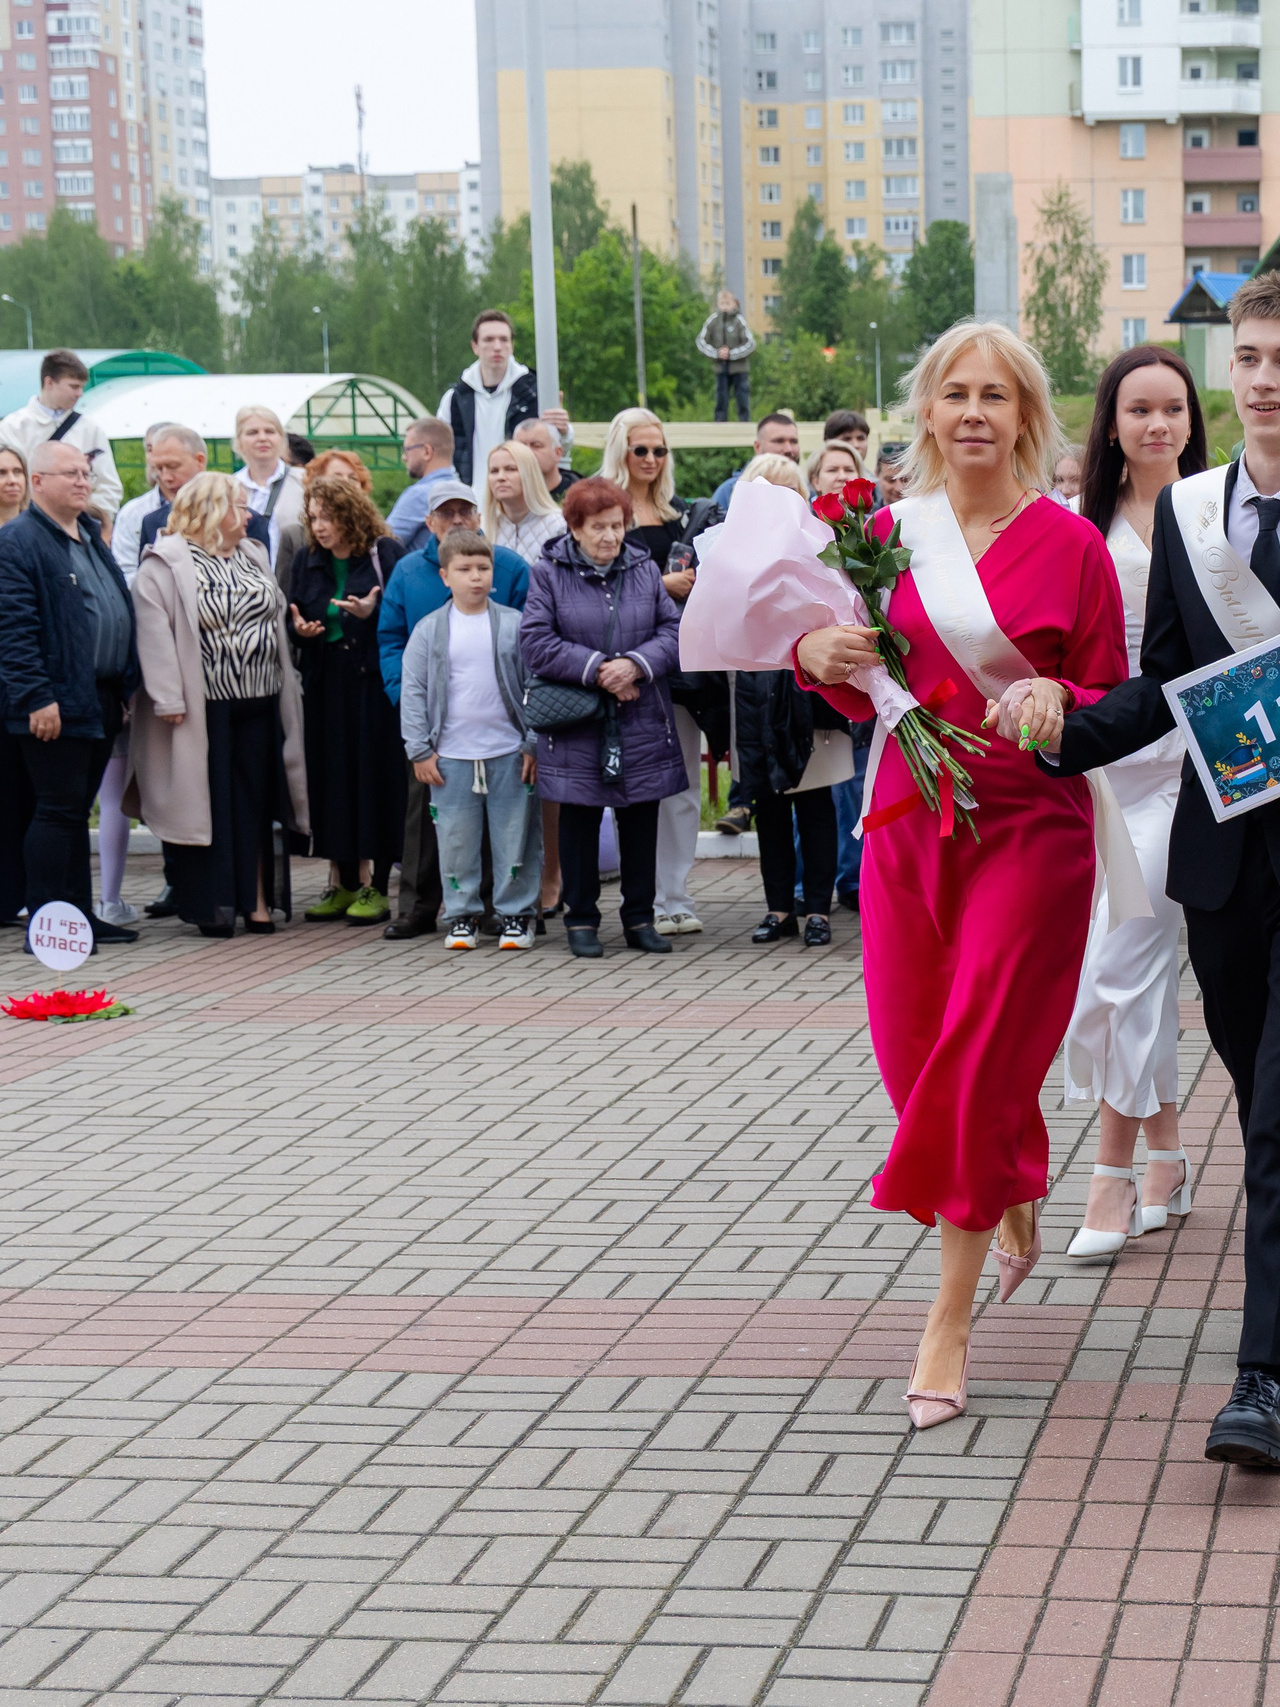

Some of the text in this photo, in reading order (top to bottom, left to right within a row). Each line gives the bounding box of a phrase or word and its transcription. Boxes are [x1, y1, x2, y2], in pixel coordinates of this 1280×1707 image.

[1201, 546, 1265, 646] Выпу
[39, 916, 52, 932] 11
[35, 933, 88, 955] класс
